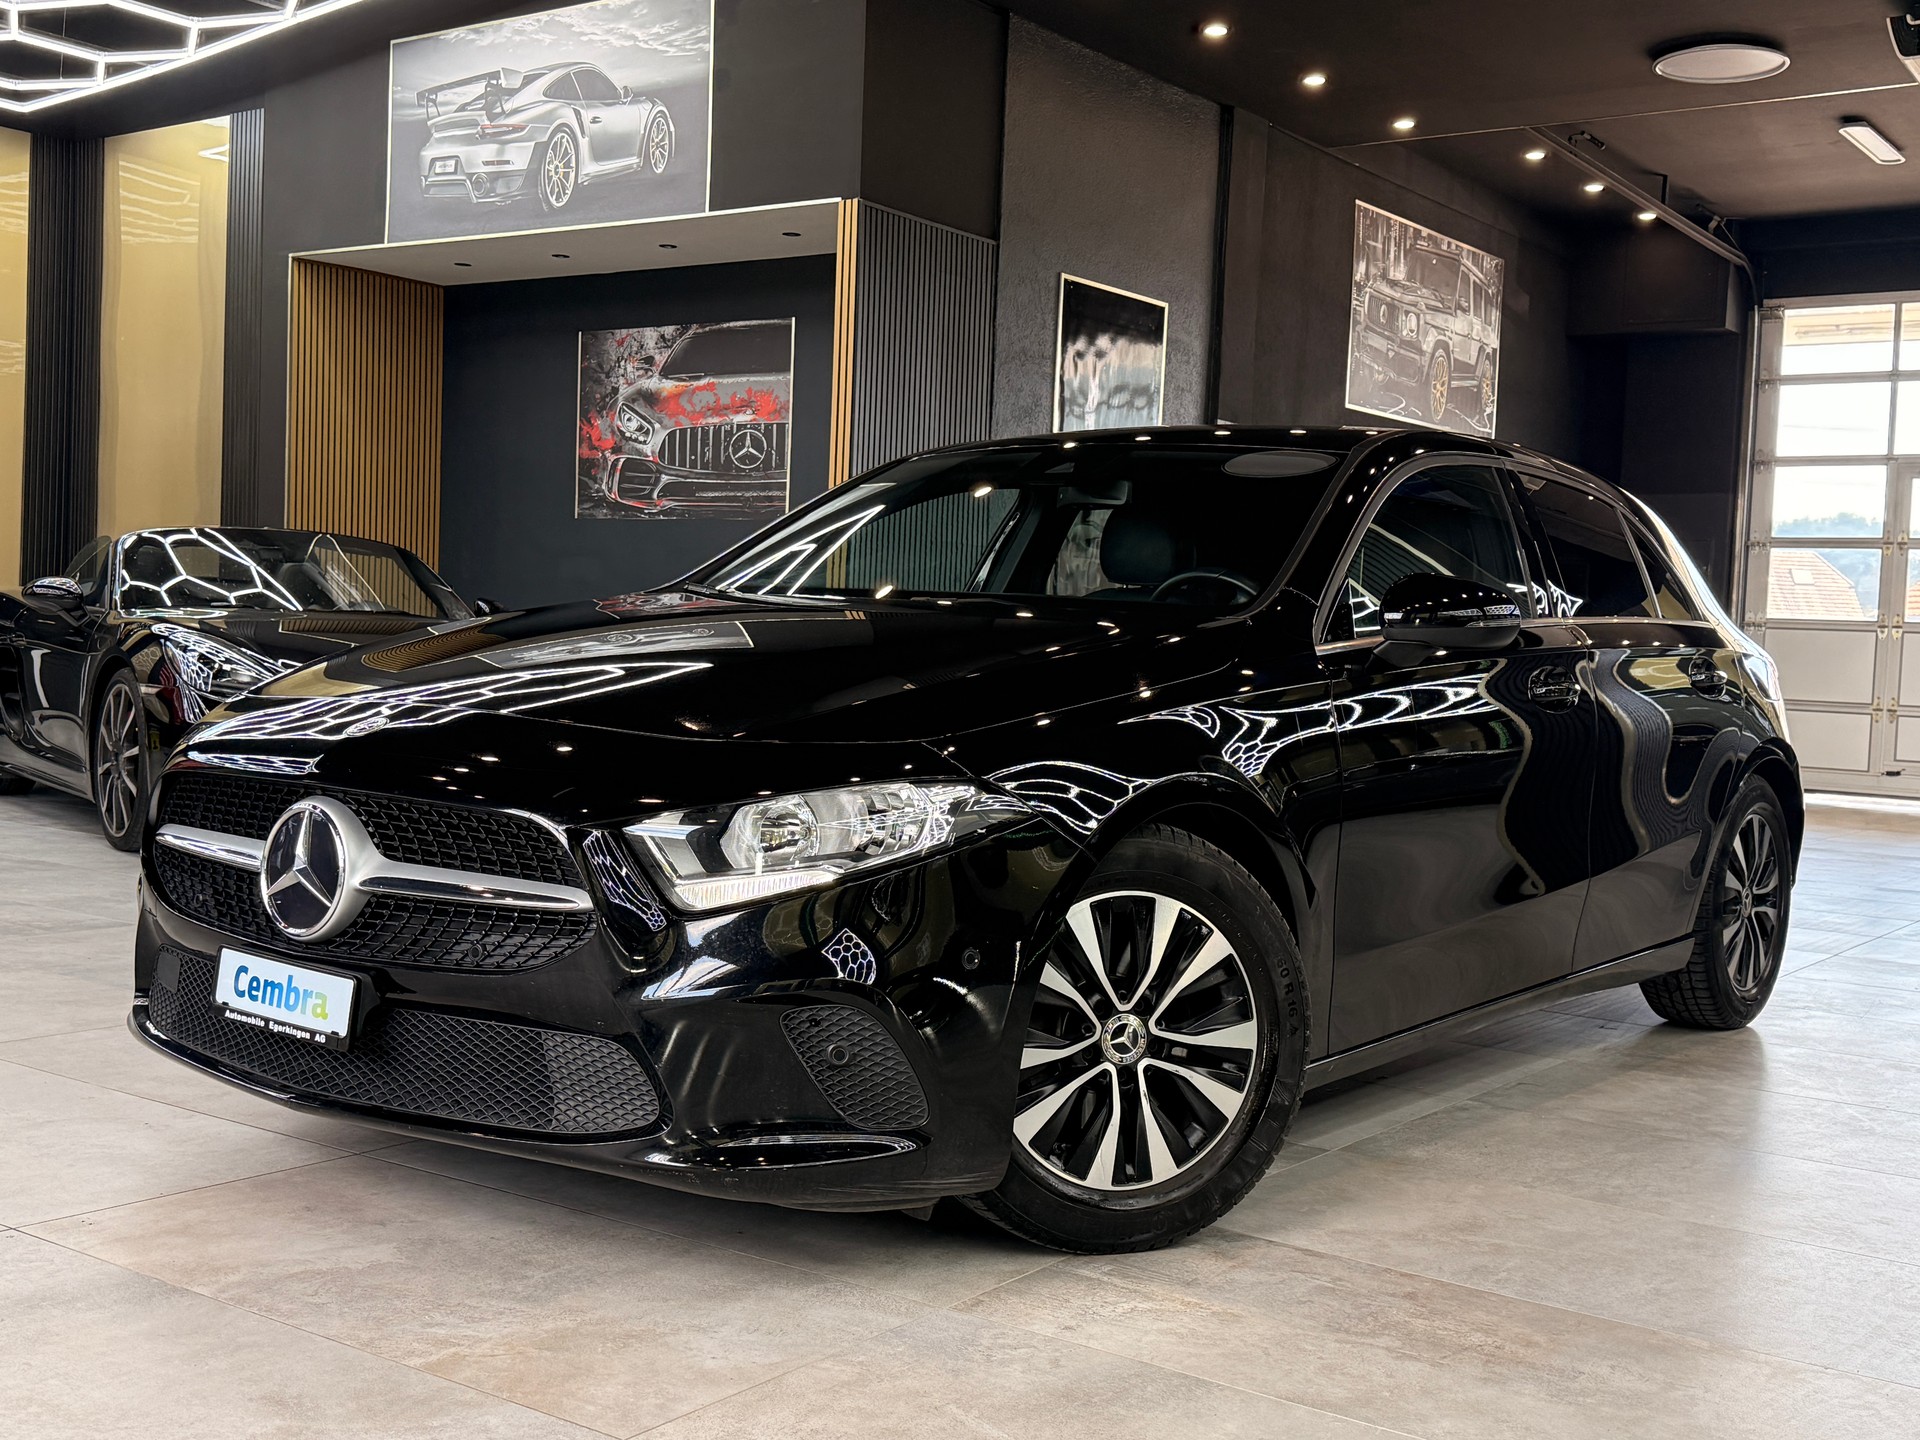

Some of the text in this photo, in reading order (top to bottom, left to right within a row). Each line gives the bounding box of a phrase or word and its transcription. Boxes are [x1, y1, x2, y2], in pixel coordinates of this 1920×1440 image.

[233, 964, 329, 1021] Cembra
[224, 1009, 326, 1043] Automobile Egerkingen AG
